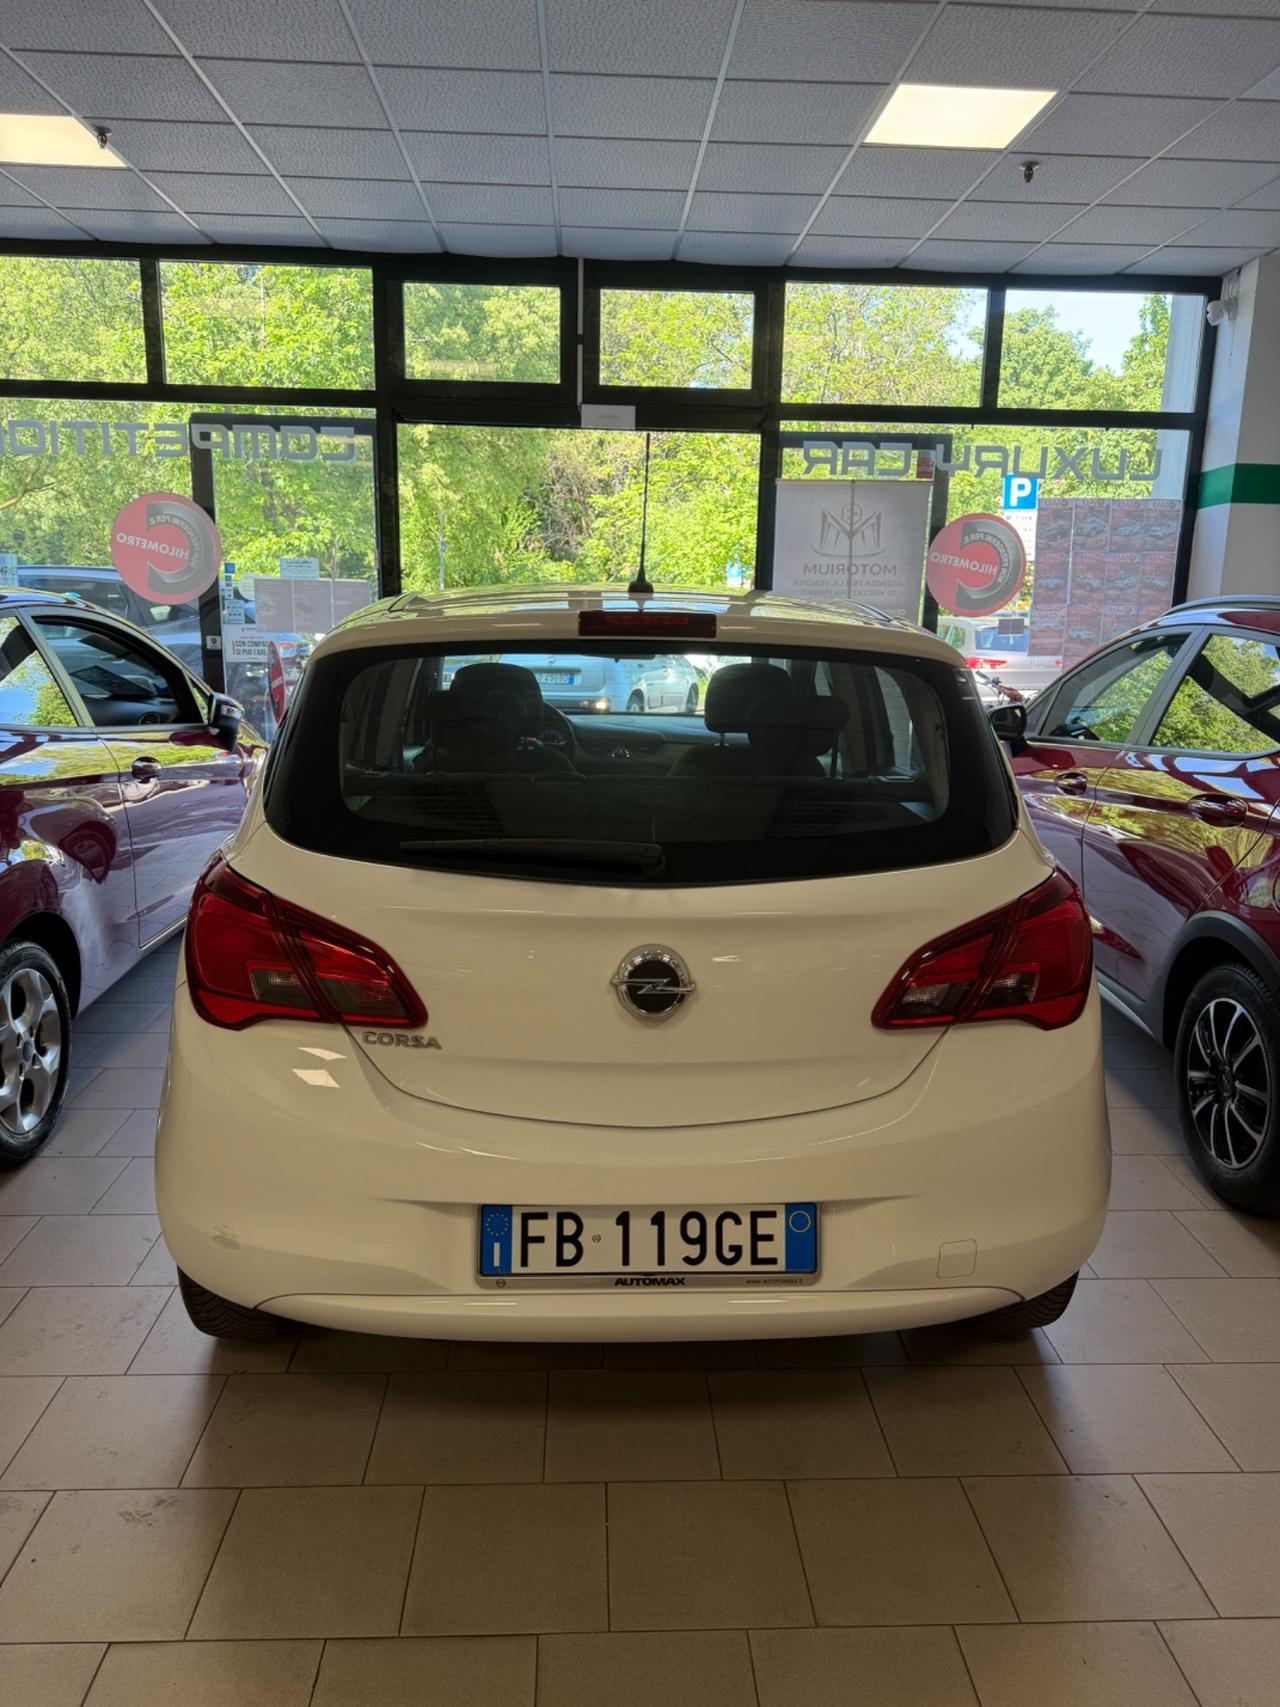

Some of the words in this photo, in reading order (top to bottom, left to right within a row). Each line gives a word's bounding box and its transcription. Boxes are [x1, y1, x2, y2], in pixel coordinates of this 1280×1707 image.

[1010, 477, 1032, 507] P
[363, 1031, 442, 1050] CORSA
[520, 1211, 584, 1268] FB
[615, 1210, 779, 1267] 119GE
[614, 1277, 686, 1287] AUTOMAX
